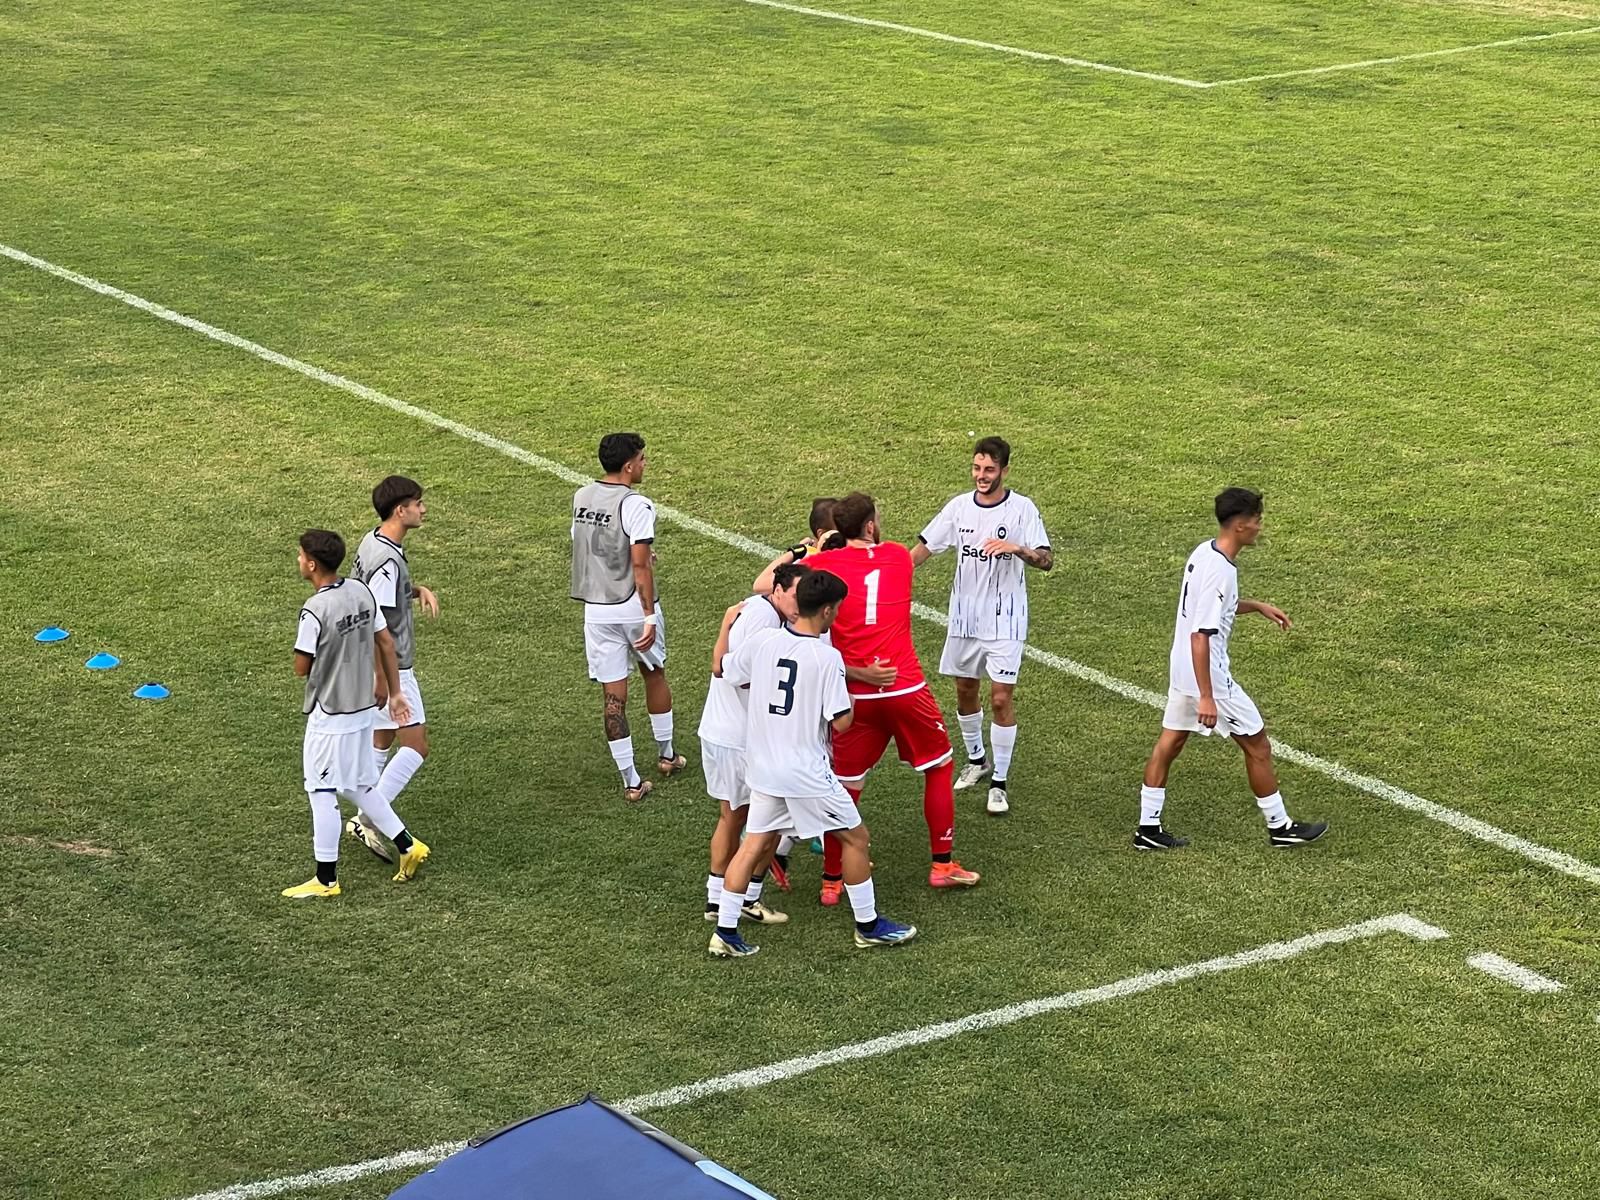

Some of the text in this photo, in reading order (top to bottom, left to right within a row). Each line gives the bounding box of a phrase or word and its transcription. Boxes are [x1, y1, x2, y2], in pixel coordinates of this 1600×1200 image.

[577, 507, 612, 523] Zeus
[864, 568, 881, 625] 1
[768, 658, 798, 716] 3
